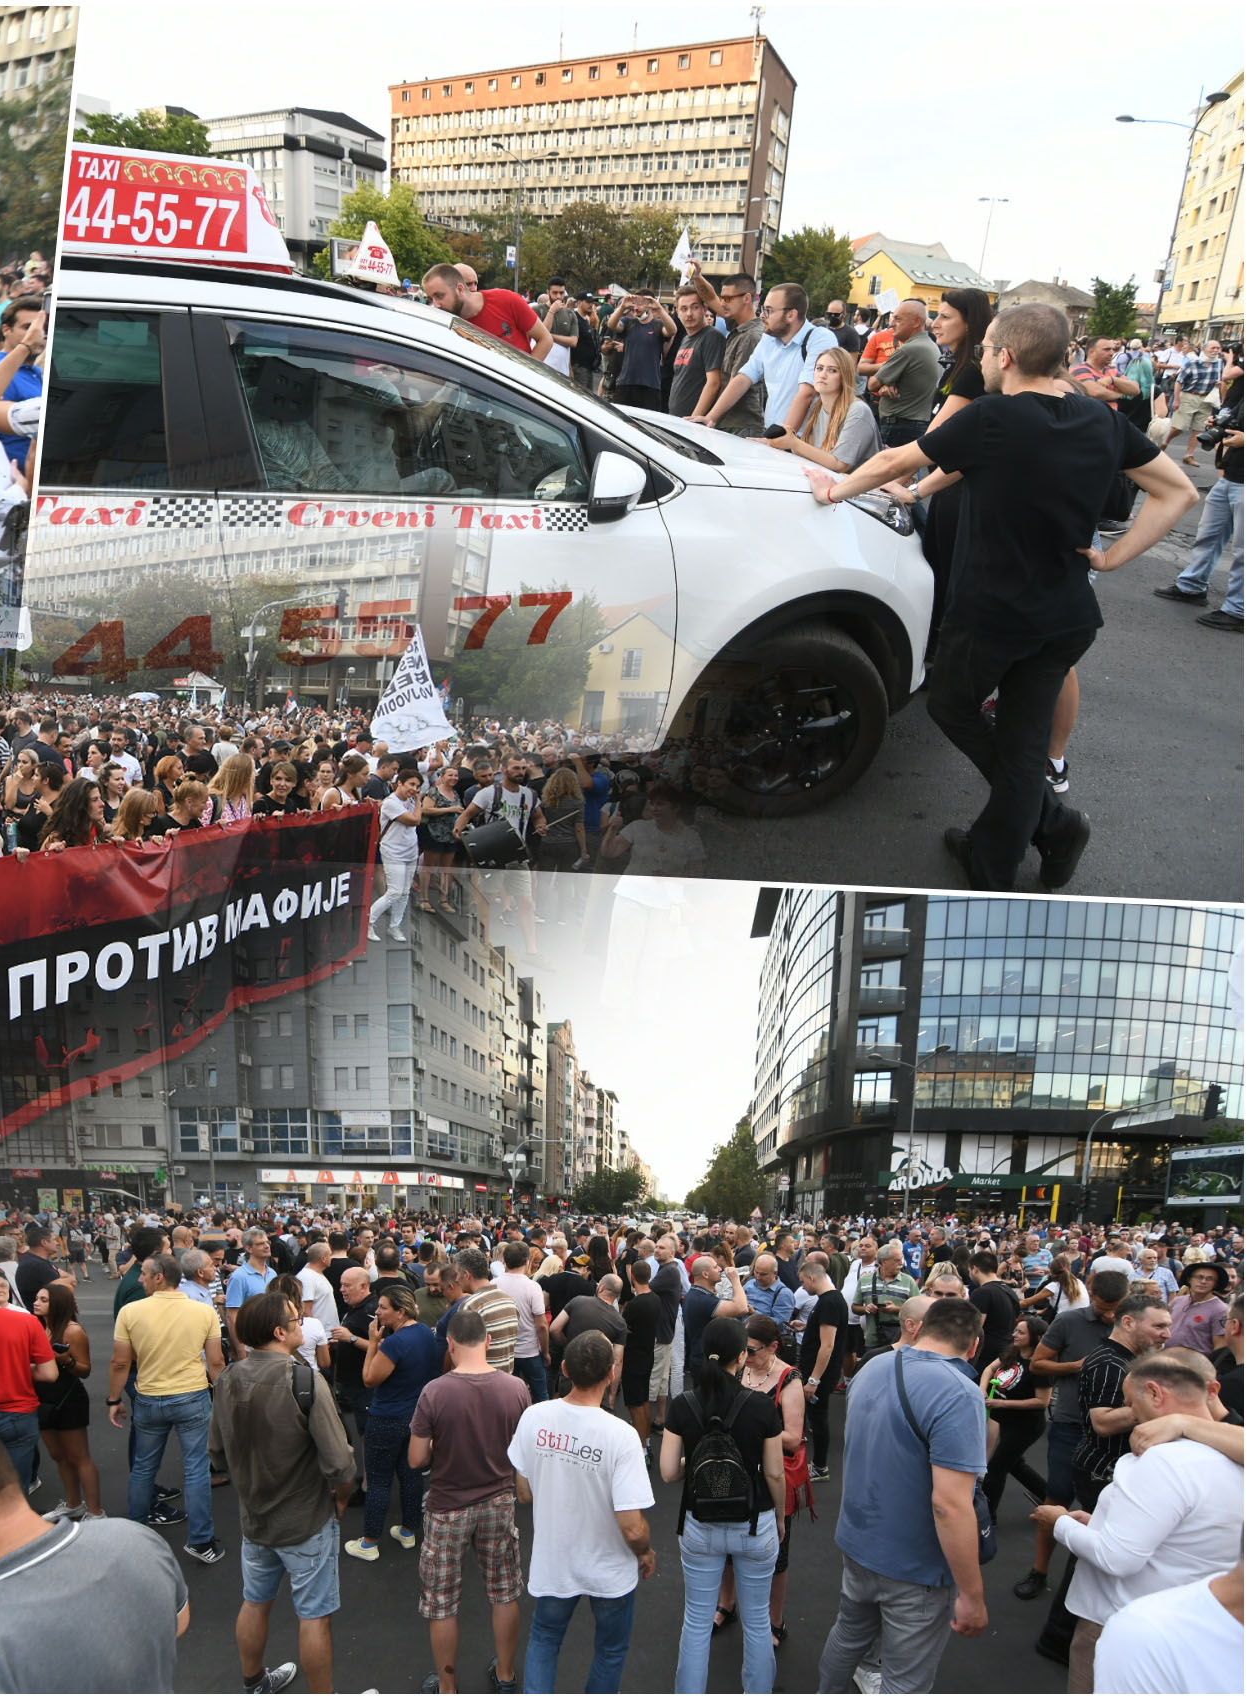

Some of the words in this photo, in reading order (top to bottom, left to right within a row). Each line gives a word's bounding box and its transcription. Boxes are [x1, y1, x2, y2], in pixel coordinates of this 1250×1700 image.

[78, 156, 121, 182] TAXI
[65, 185, 240, 247] 44-55-77
[287, 502, 436, 528] Crveni
[452, 505, 544, 530] Taxi
[53, 614, 224, 683] 44
[454, 591, 573, 651] 77
[7, 913, 219, 1021] ПРОТИВ
[224, 871, 351, 944] МАФИЈЕ
[887, 1166, 954, 1191] AROMA
[971, 1176, 1001, 1187] Market
[910, 1251, 921, 1269] 9
[537, 1429, 603, 1463] StilLes
